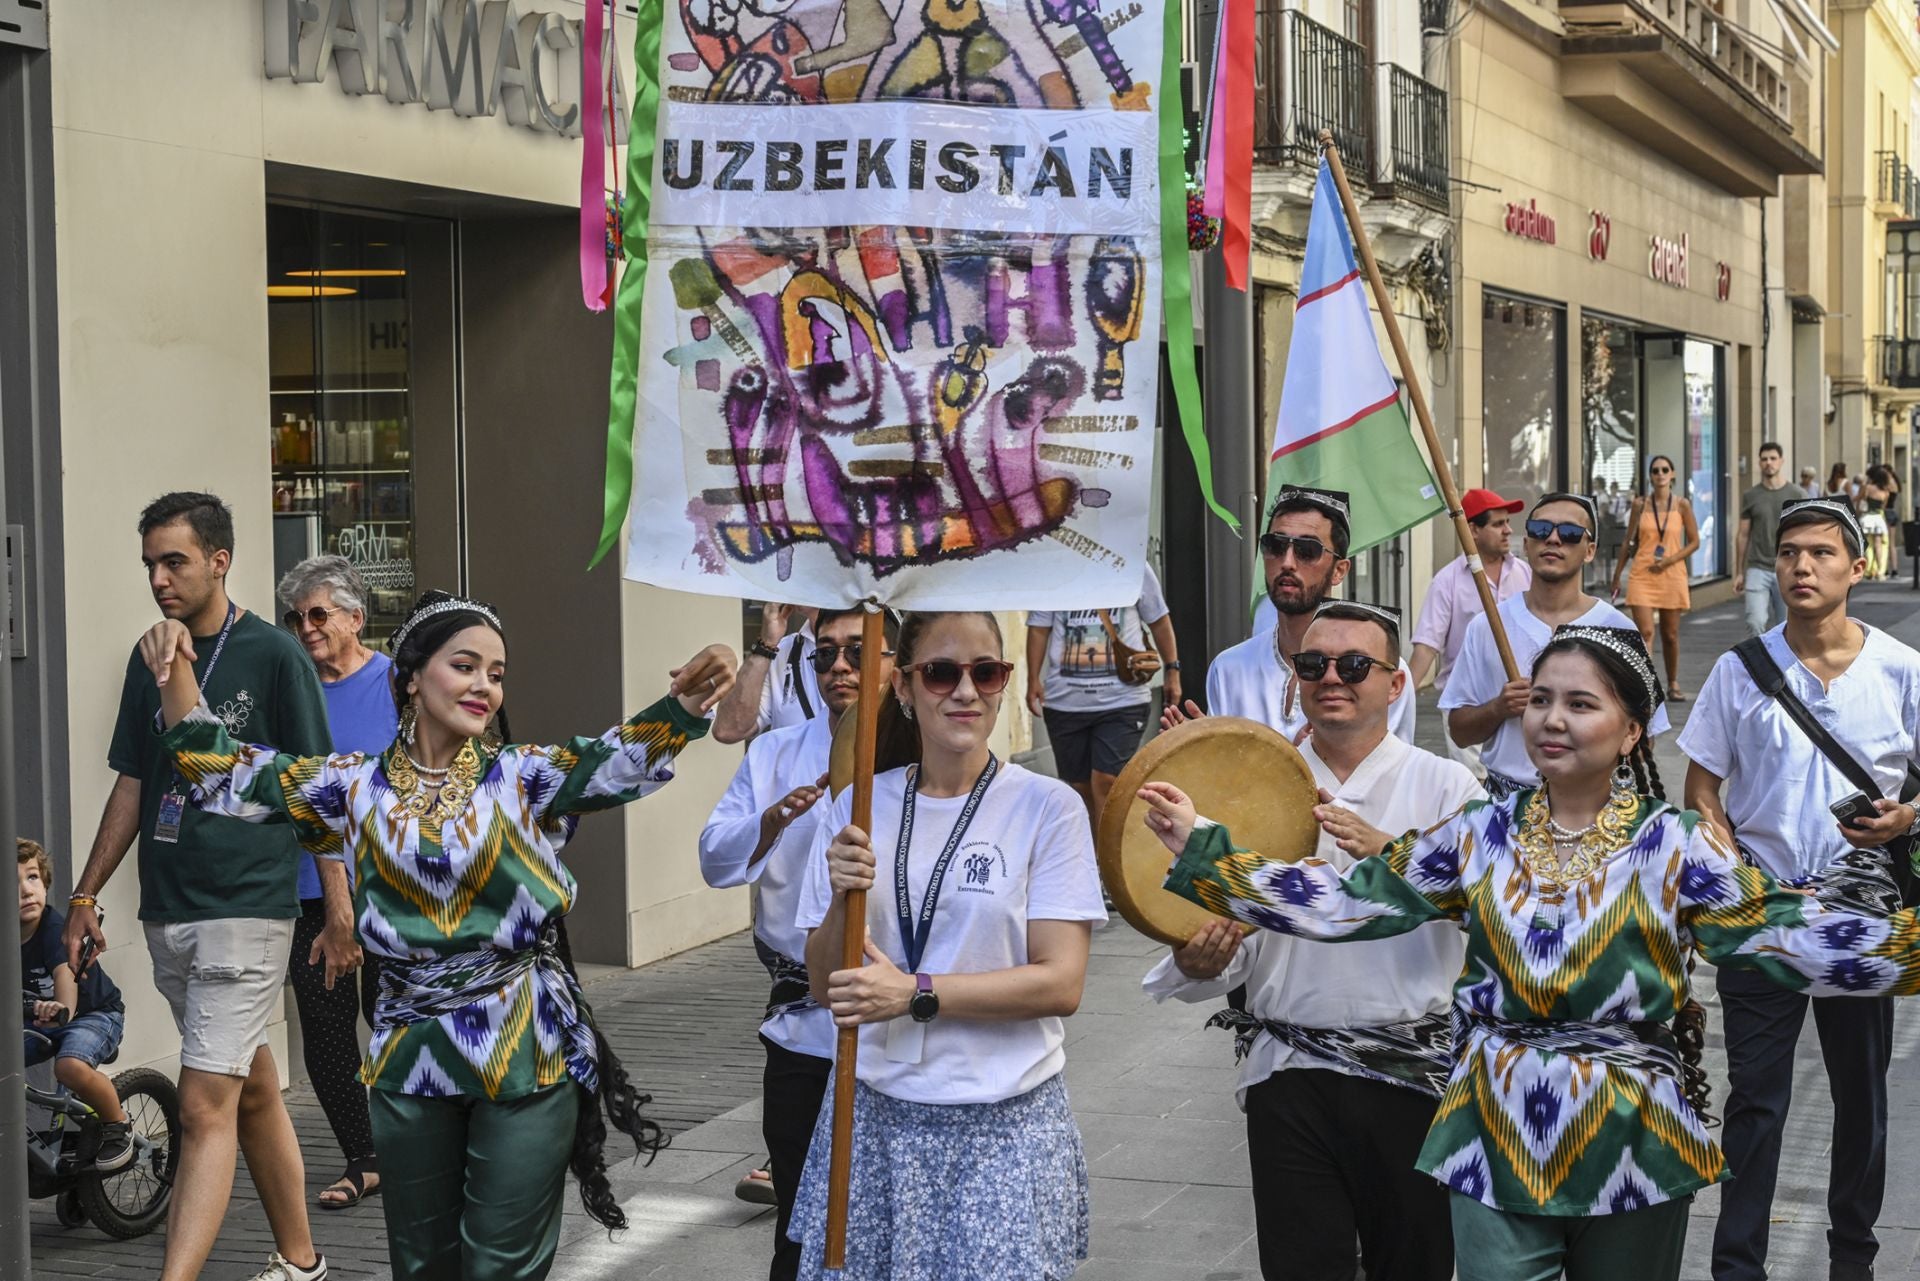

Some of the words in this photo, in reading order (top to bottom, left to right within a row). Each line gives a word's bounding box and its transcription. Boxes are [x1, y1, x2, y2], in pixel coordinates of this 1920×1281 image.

[264, 0, 631, 147] FARMACA
[662, 129, 1134, 200] UZBEKISTÁN
[1648, 232, 1689, 289] arenal
[1069, 608, 1119, 619] MIAI
[906, 791, 913, 801] DE
[964, 781, 987, 816] FOLKLÓRICO
[900, 801, 913, 847] INTERNACIONAL
[940, 816, 969, 861] INTERNACIONAL
[897, 847, 907, 887] FOLKLÓRICO
[936, 861, 946, 872] DE
[899, 888, 909, 918] FESTIVAL
[922, 872, 942, 921] EXTREMADURA
[958, 885, 995, 896] Extremadura
